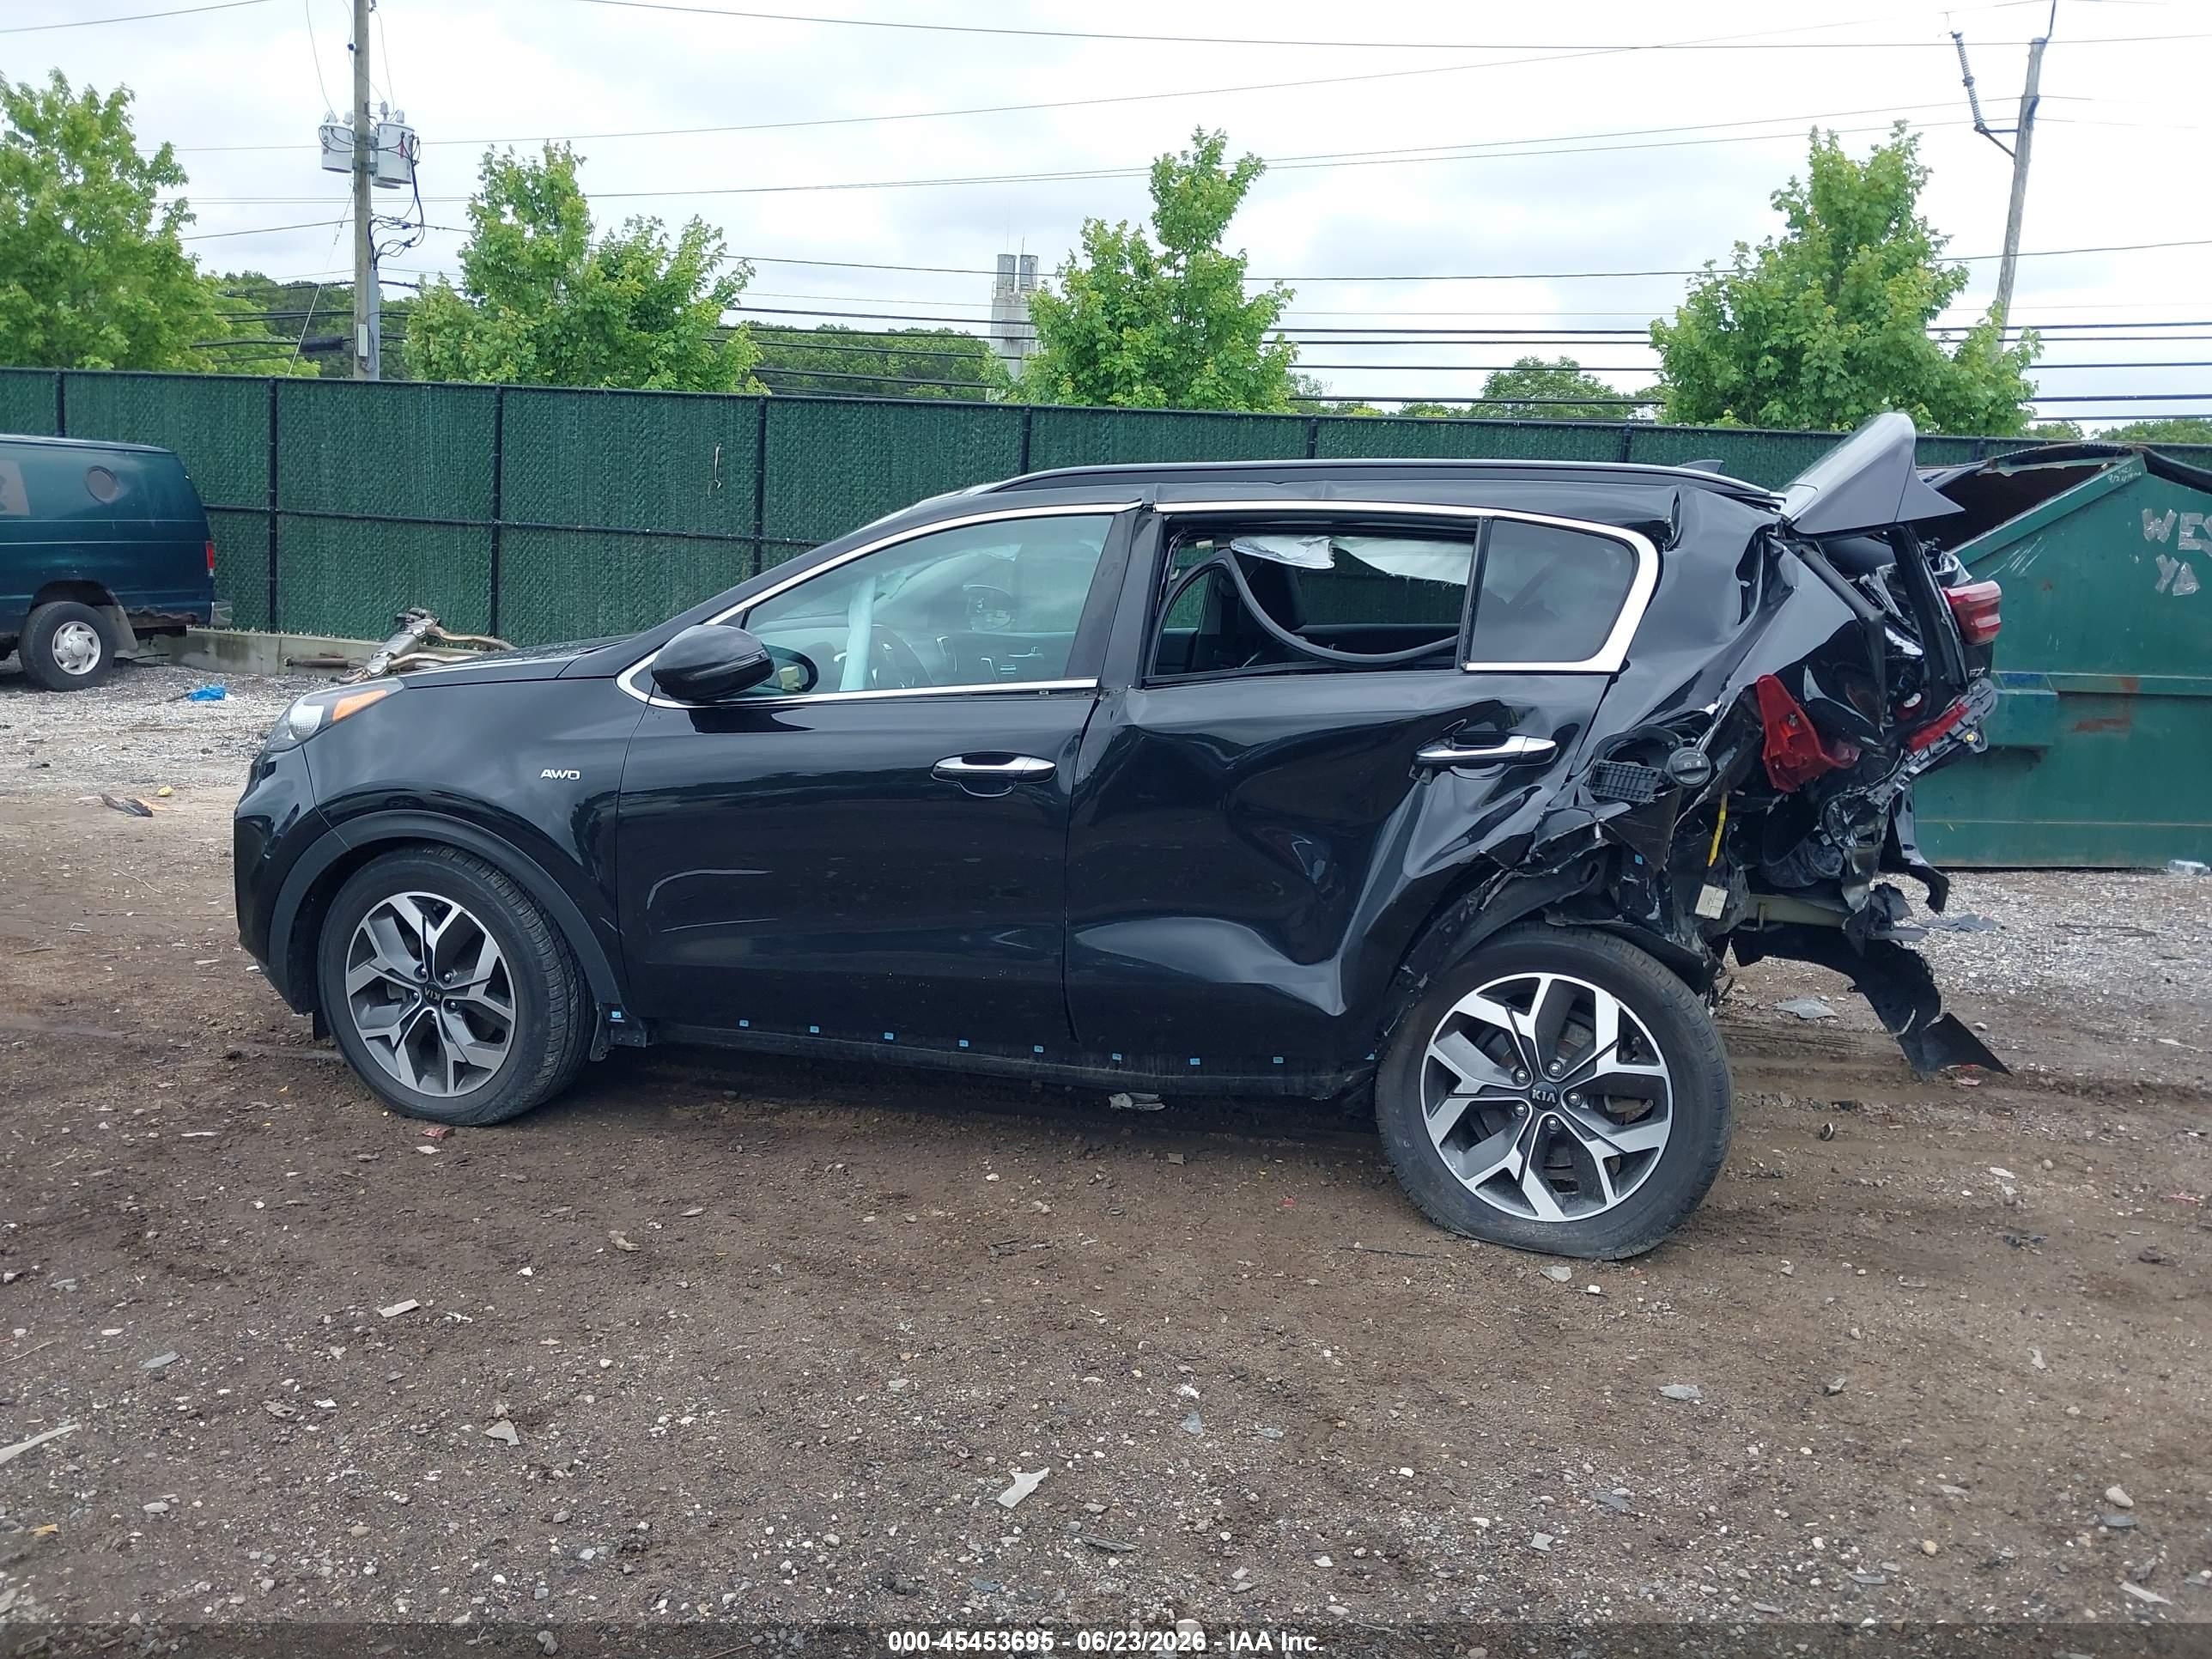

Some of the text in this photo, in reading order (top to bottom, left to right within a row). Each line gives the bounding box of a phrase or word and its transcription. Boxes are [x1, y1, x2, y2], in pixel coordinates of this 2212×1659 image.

[540, 769, 580, 781] AWD
[424, 987, 441, 1002] KIA
[1531, 1089, 1557, 1103] KIA
